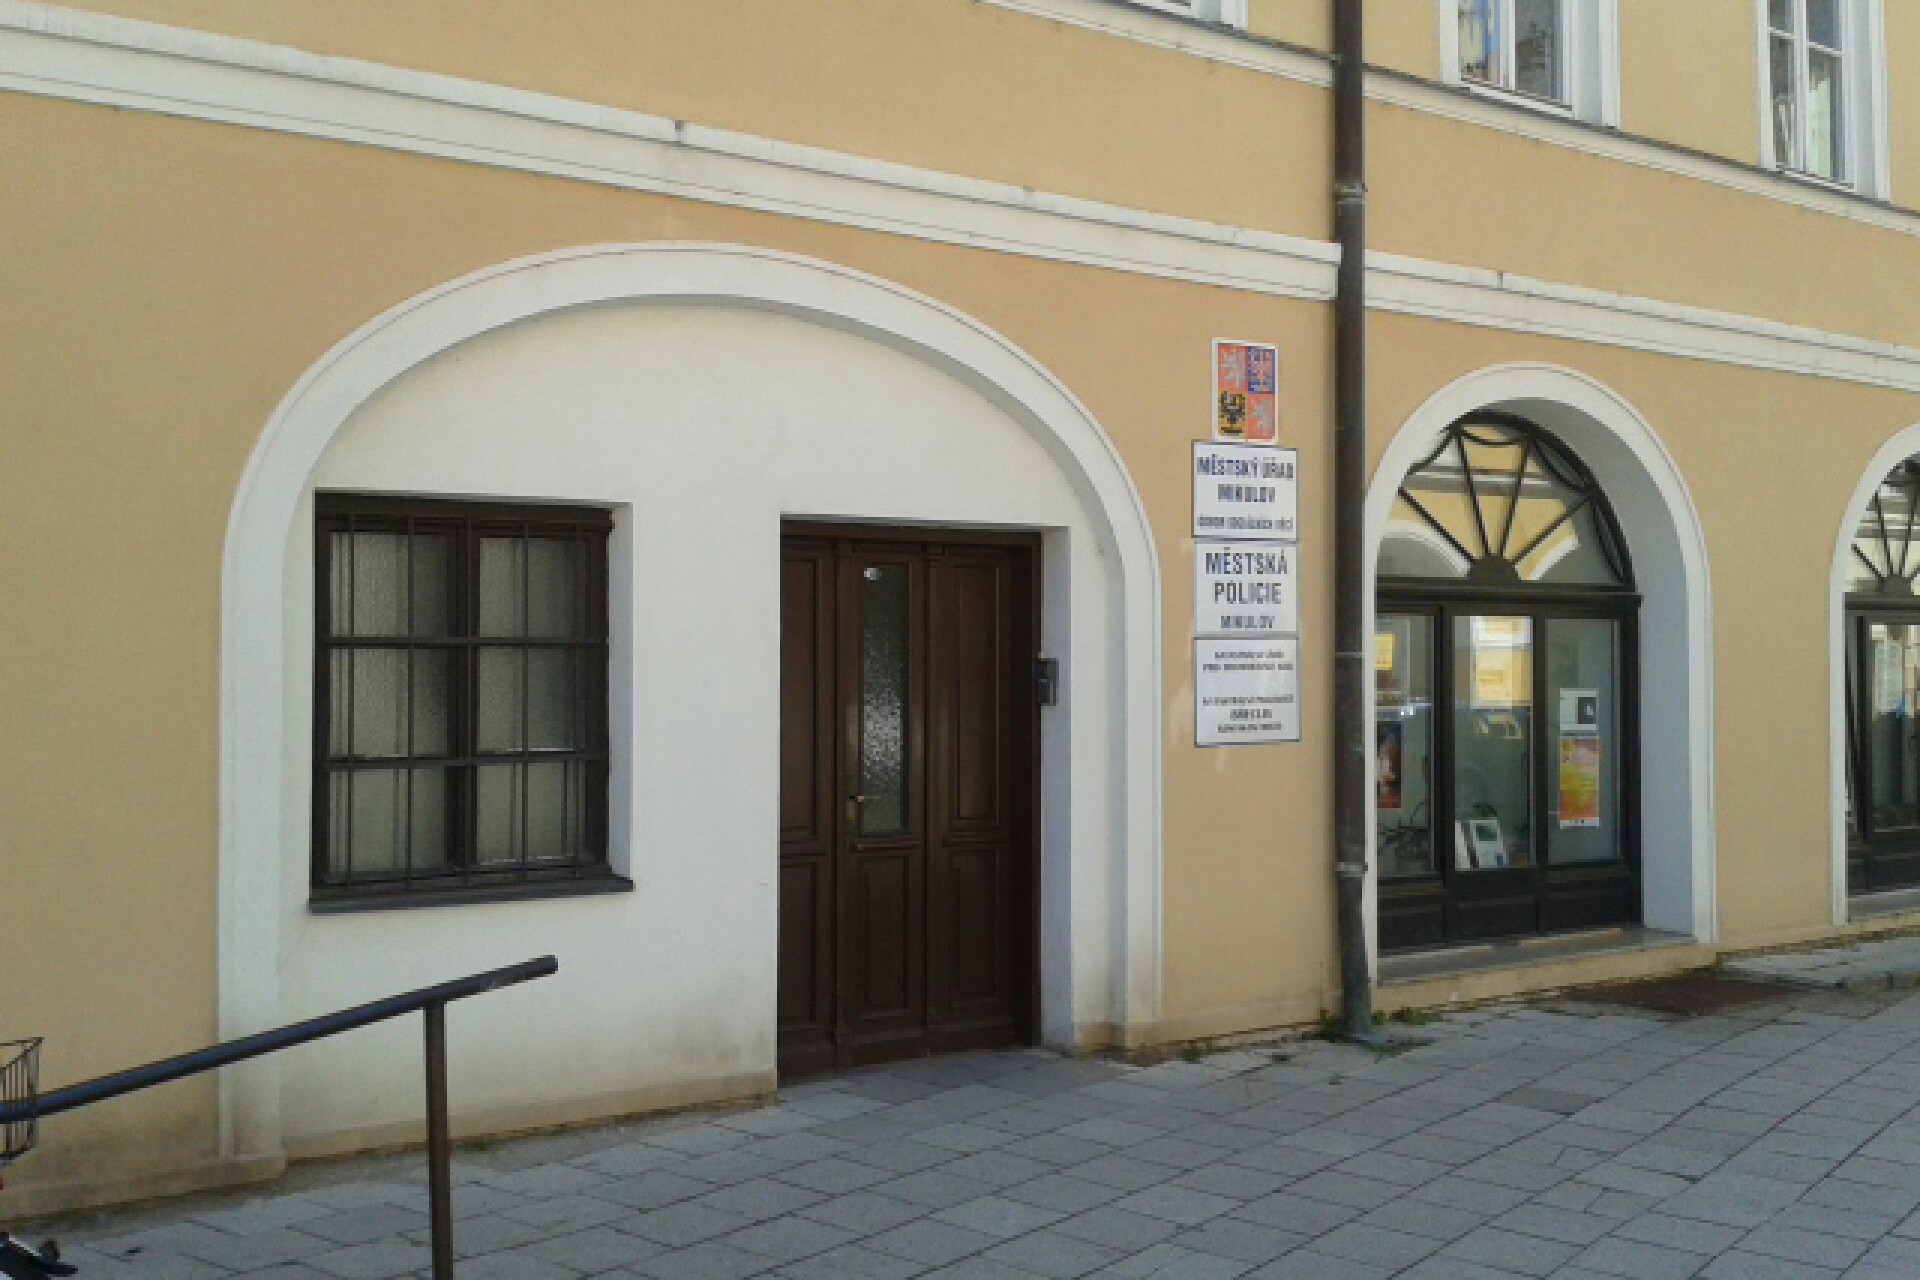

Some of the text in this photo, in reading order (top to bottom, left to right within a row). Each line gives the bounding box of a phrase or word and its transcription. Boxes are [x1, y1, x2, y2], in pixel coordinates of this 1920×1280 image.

[1218, 484, 1276, 502] MIKULOV
[1205, 547, 1288, 574] MĚSTSKÁ
[1214, 581, 1282, 604] POLICIE
